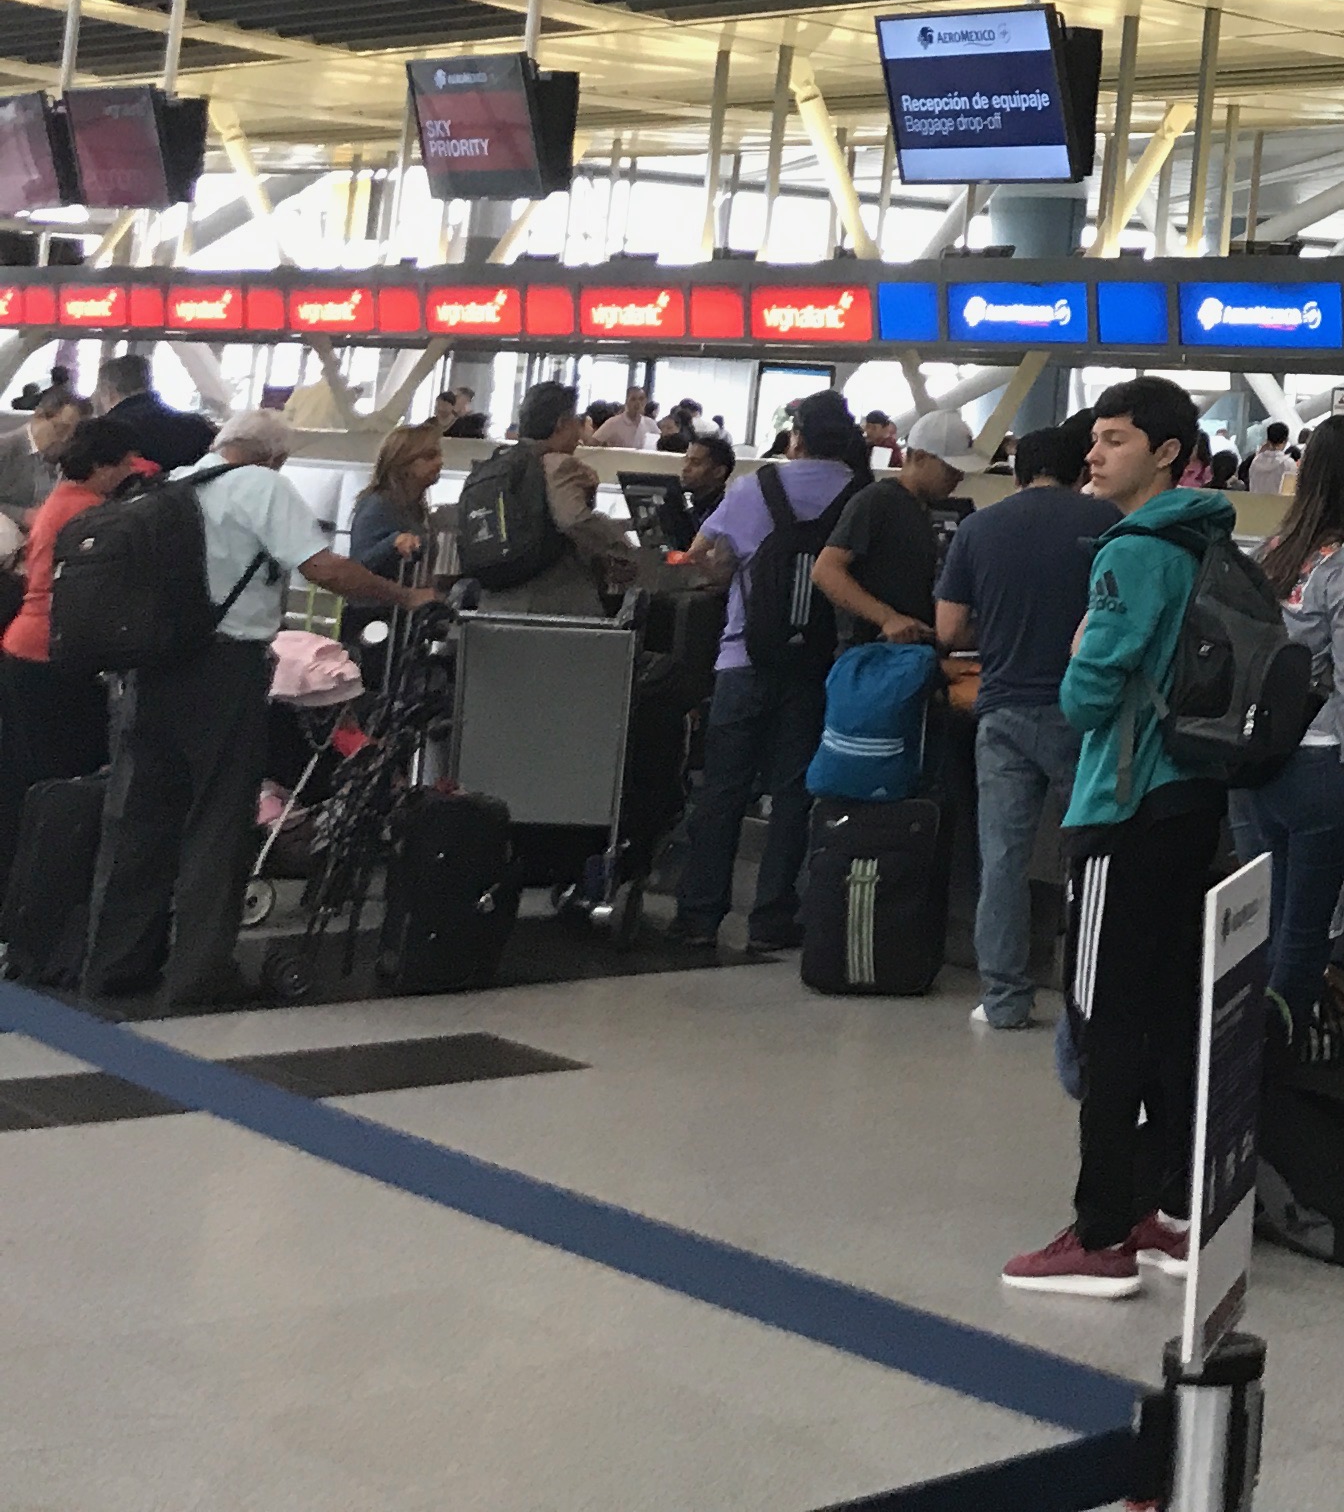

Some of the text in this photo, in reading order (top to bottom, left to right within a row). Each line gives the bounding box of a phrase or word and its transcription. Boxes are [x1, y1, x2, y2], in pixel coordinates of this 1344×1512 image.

[901, 89, 1050, 114] Recepción de equipaje
[425, 119, 452, 138] SKY
[904, 115, 955, 136] Baggage
[428, 138, 490, 158] PRIORITY
